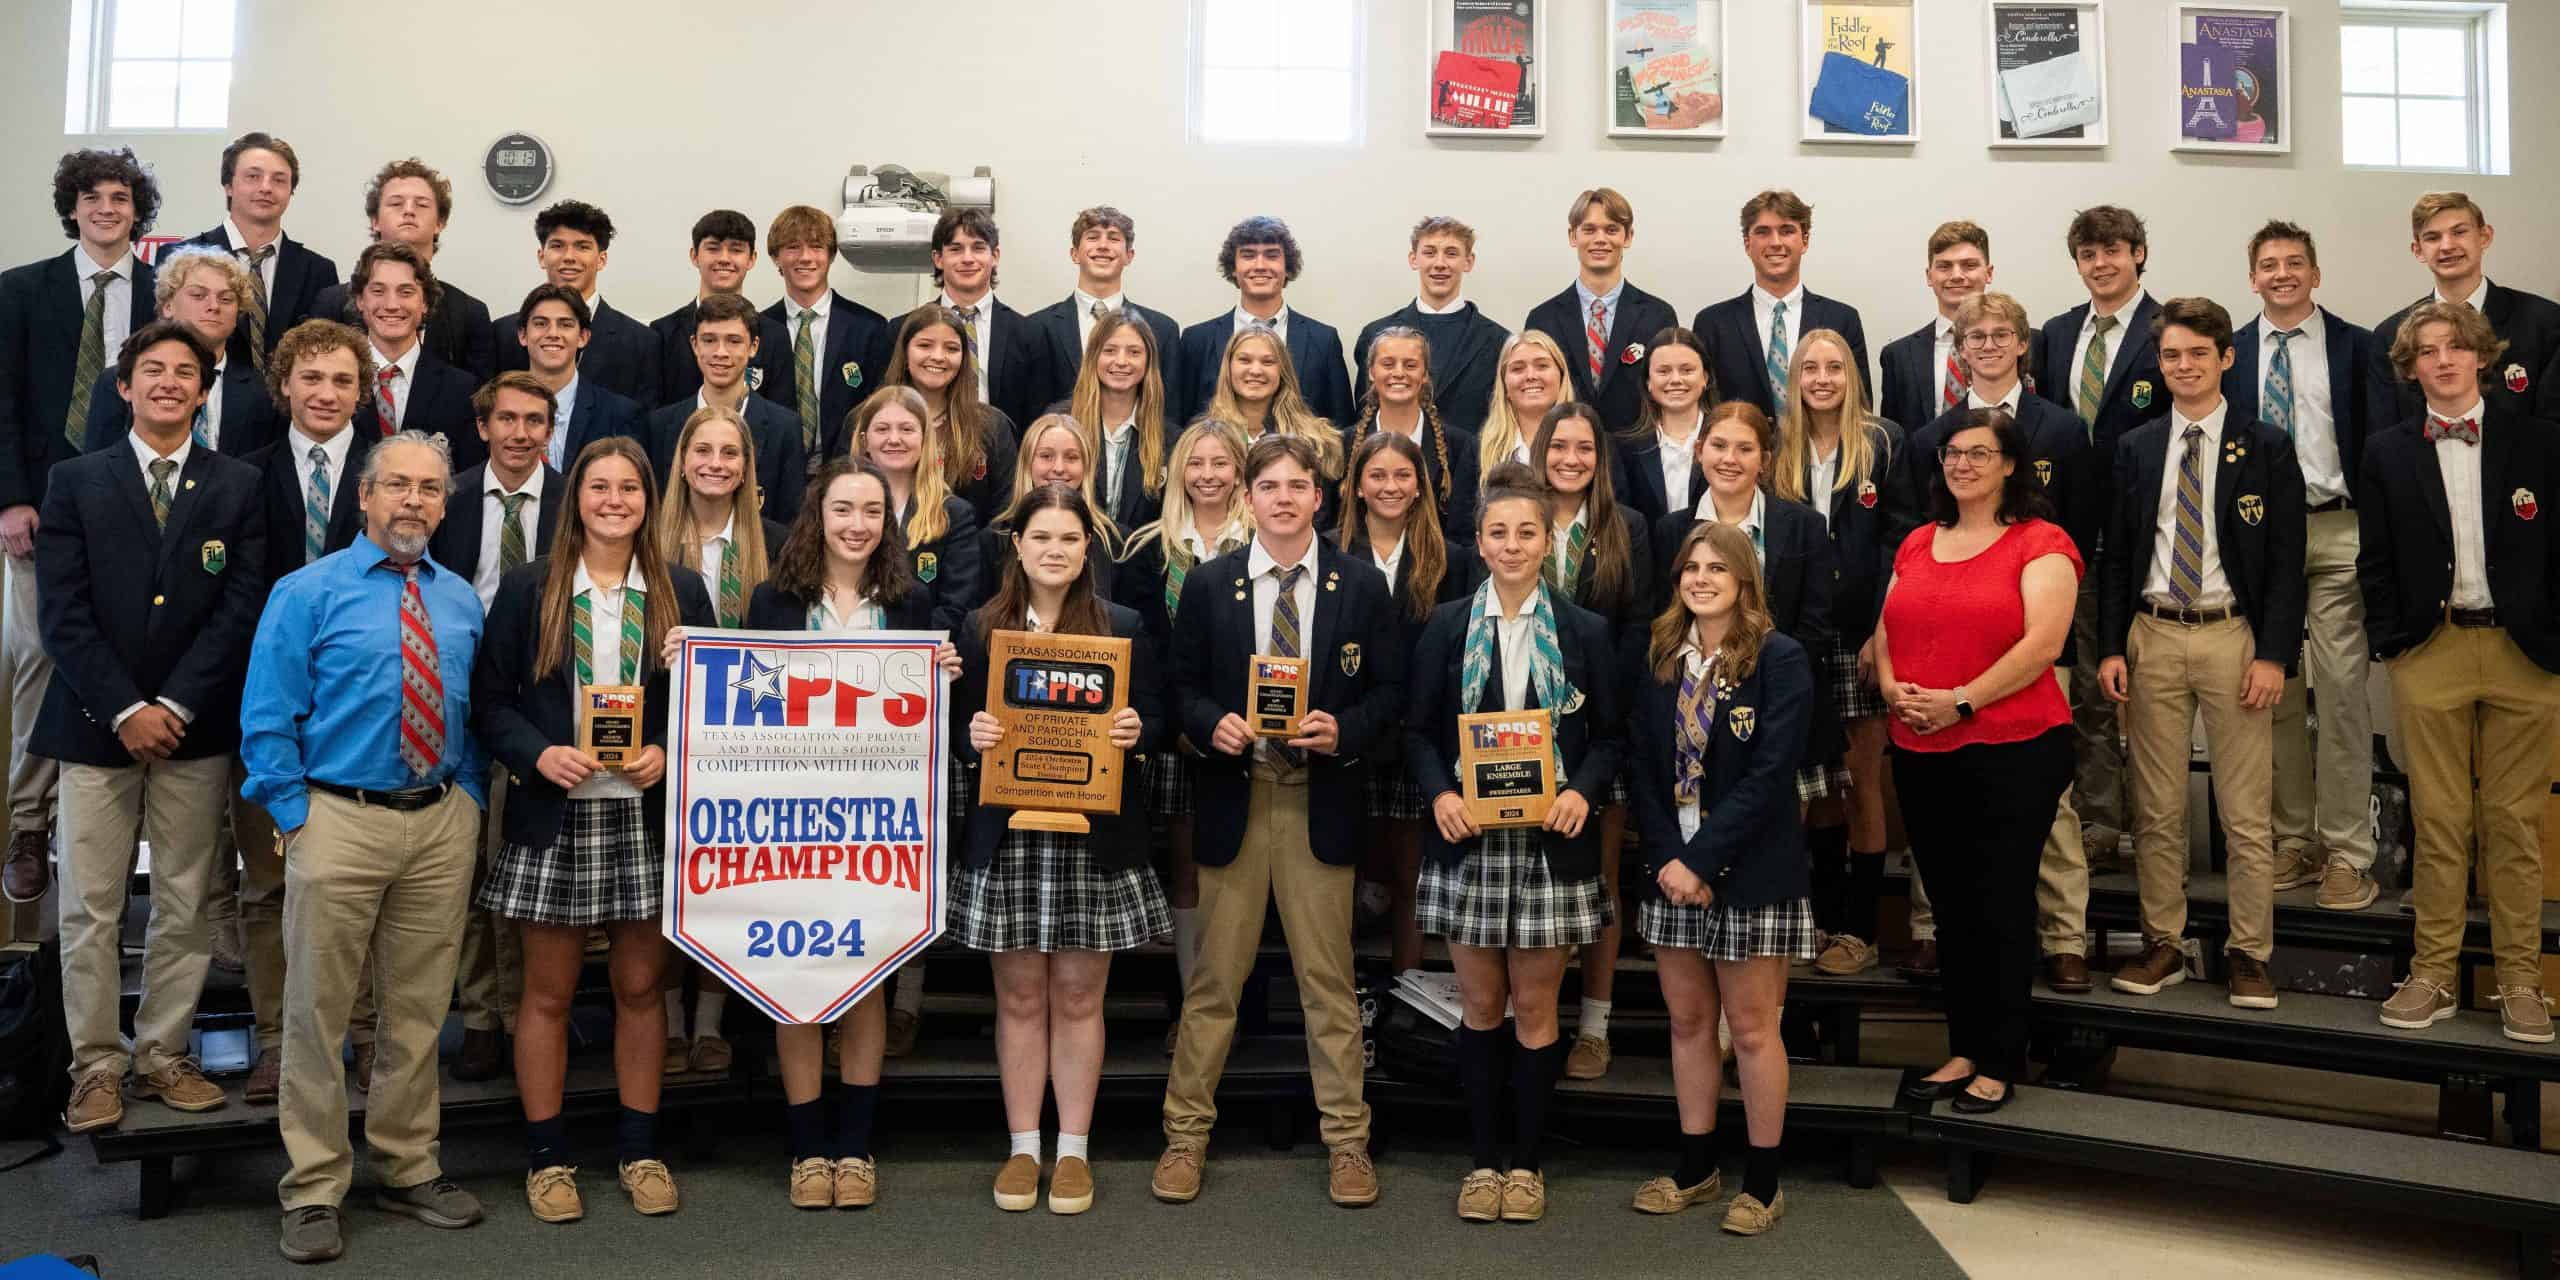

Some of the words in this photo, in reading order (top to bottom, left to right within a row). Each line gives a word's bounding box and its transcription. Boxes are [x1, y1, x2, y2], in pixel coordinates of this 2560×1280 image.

[1830, 16, 1872, 36] Fiddler
[2200, 23, 2273, 39] ANASTASIA
[1839, 34, 1867, 51] Roof
[2012, 30, 2062, 42] Cinderella
[2181, 84, 2234, 99] ANASTASIA
[1007, 645, 1041, 657] TEXAS
[1041, 648, 1118, 661] ASSOCIATION
[1258, 663, 1298, 681] TAPPS
[694, 648, 928, 727] TAPPS
[1015, 668, 1104, 704] TAPPS
[592, 693, 635, 710] TAPPS
[1025, 713, 1041, 721] OF
[1042, 714, 1089, 726] PRIVATE
[703, 731, 746, 741] TEXAS
[751, 731, 840, 741] ASSOCIATION
[845, 732, 861, 741] OF
[867, 732, 921, 742] PRIVATE
[1011, 723, 1035, 734] AND
[1037, 725, 1098, 737] PAROCHIAL
[1470, 721, 1544, 749] TAPPS
[718, 744, 749, 754] AND
[755, 744, 835, 754] PAROCHIAL
[842, 745, 907, 754] SCHOOLS
[1028, 735, 1082, 748] SCHOOLS
[696, 759, 809, 772] COMPETITION
[811, 759, 858, 771] WITH
[862, 759, 920, 771] HONOR
[1495, 764, 1522, 772] LARGE
[1486, 770, 1532, 780] ENSEMBLE
[995, 785, 1054, 799] Competition
[1056, 790, 1076, 799] with
[1078, 791, 1106, 801] Honor
[689, 796, 924, 845] ORCHESTRA
[687, 844, 924, 895] CHAMPION
[747, 918, 865, 958] 2024
